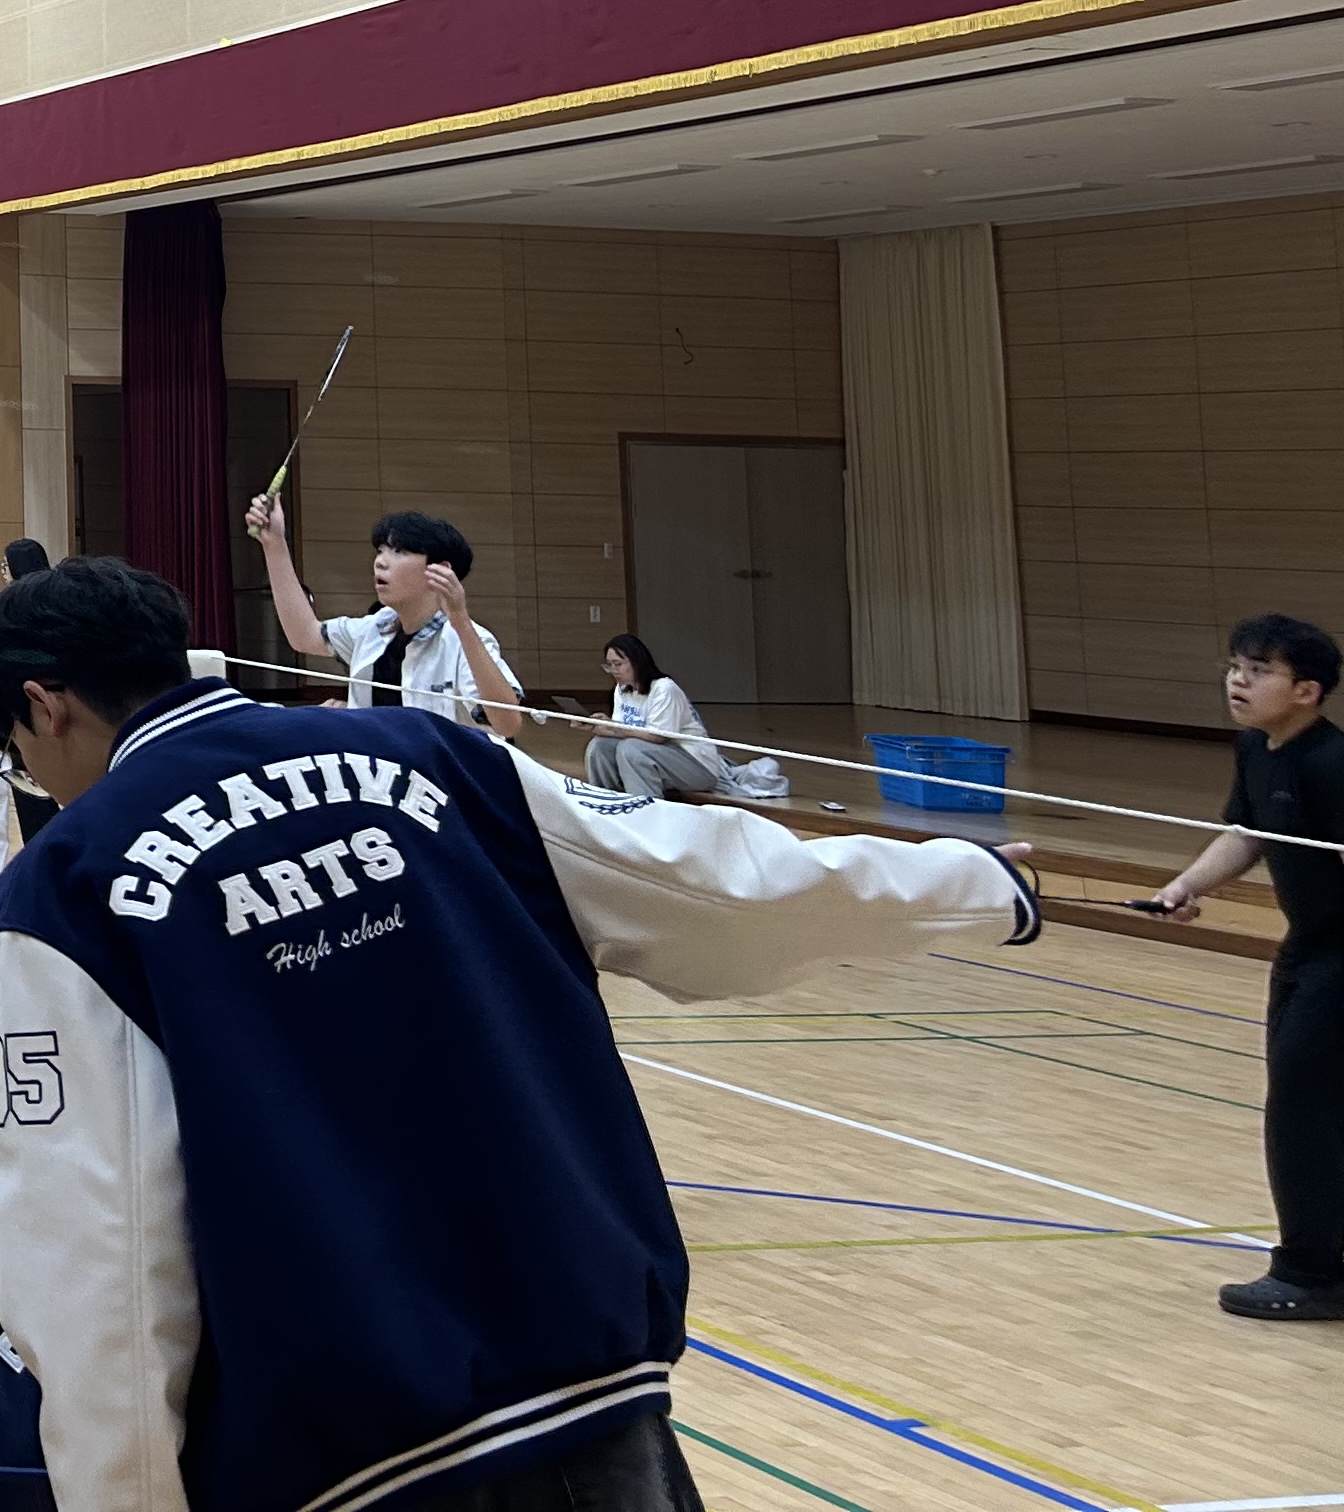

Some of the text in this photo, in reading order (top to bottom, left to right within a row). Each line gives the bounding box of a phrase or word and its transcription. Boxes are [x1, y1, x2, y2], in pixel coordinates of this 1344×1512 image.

[109, 752, 448, 921] CREATIVE
[217, 826, 406, 936] ARTS
[265, 902, 406, 973] High school
